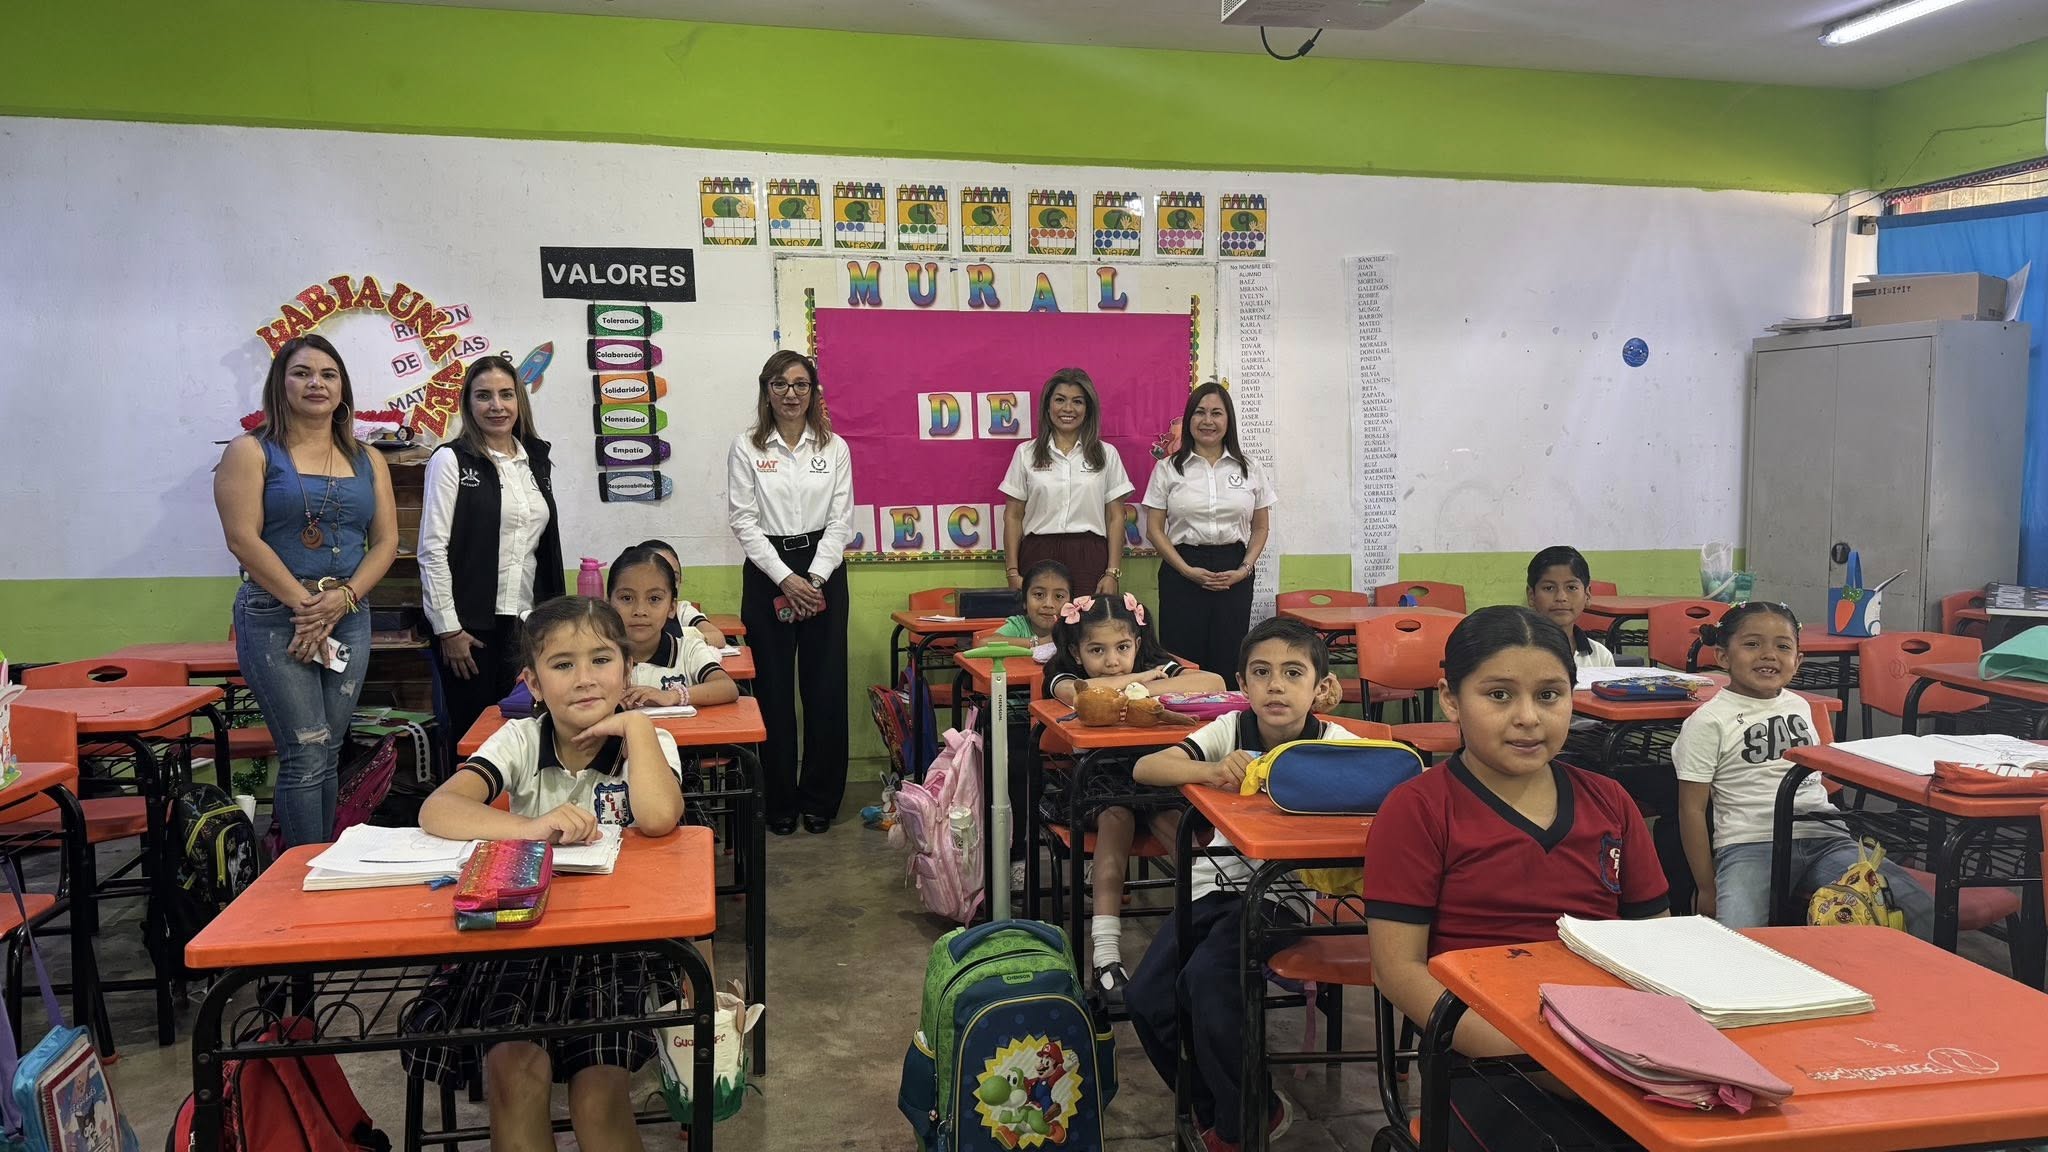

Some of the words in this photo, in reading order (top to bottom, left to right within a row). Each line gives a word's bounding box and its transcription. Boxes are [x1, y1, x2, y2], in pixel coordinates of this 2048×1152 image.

[853, 200, 865, 221] 3
[917, 203, 929, 224] 4
[981, 205, 993, 226] 5
[1175, 209, 1188, 229] 8
[1238, 211, 1250, 231] 9
[547, 262, 687, 287] VALORES
[847, 260, 1128, 313] MURAL
[1358, 284, 1389, 292] GALLEGOS
[257, 275, 385, 358] HABIA
[387, 282, 459, 362] UNA
[392, 354, 420, 375] DE
[451, 336, 486, 358] LAS
[604, 386, 645, 394] Solidaridad
[928, 392, 1020, 437] DE
[756, 459, 779, 469] UAT
[1741, 714, 1814, 764] SAS
